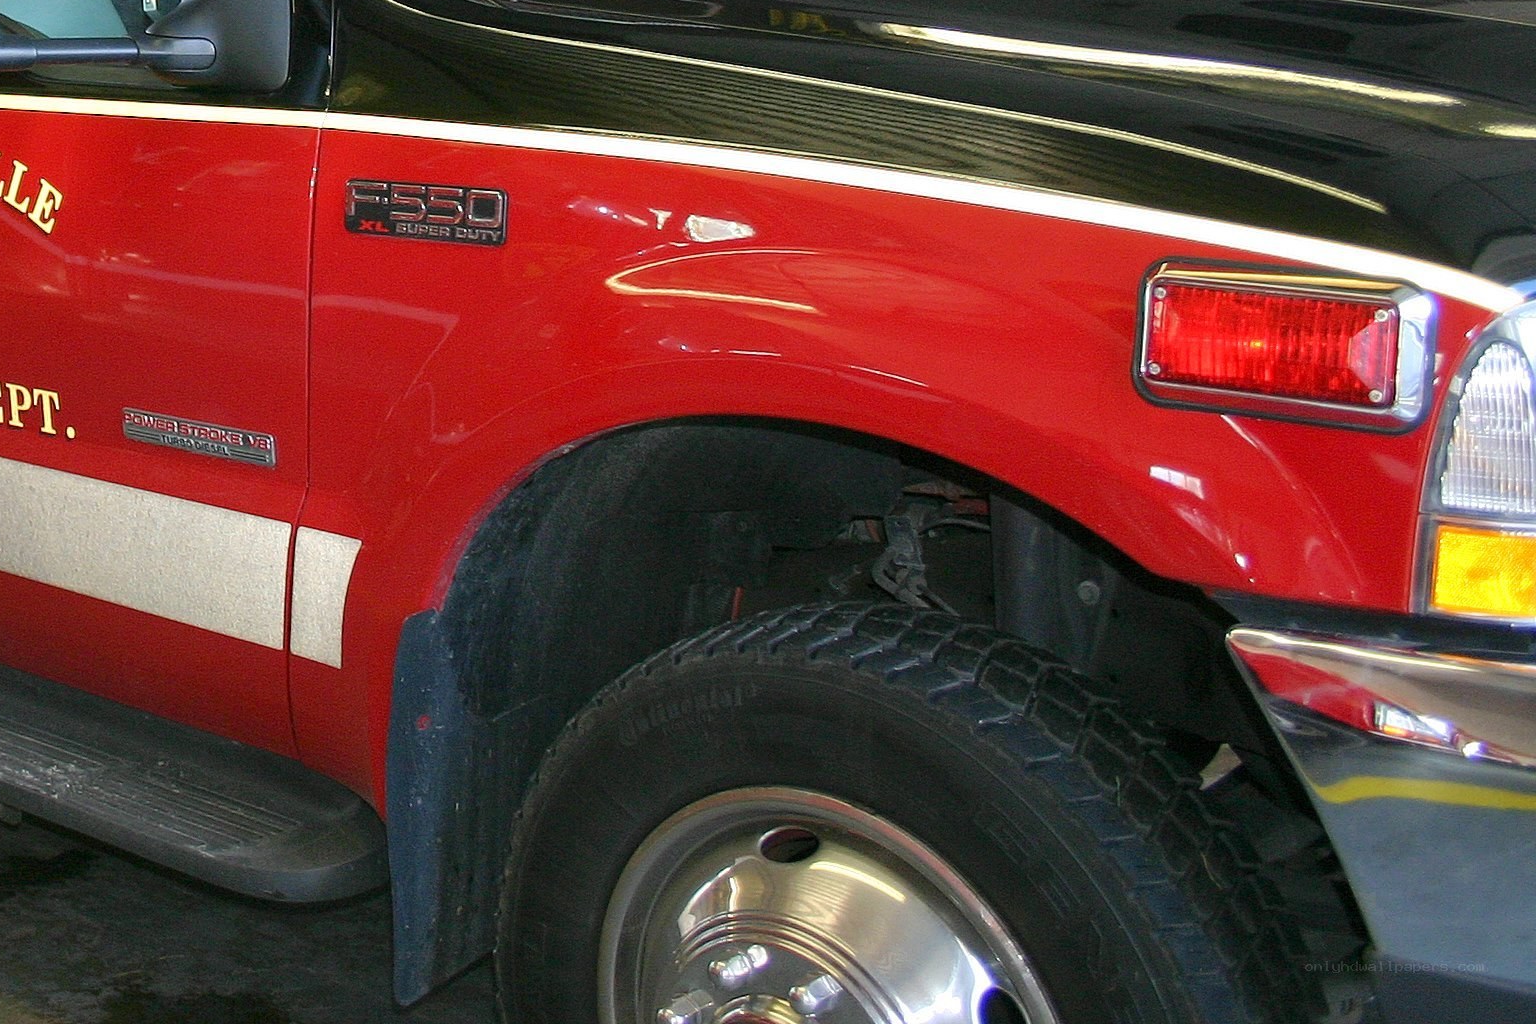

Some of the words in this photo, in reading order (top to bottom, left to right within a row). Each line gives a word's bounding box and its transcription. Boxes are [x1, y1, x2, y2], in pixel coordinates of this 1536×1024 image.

[358, 220, 390, 233] XL
[395, 222, 451, 238] SUPER
[454, 227, 503, 242] DUTY
[124, 412, 177, 433] POWER
[178, 423, 244, 446] STROKE
[247, 434, 272, 450] V8
[194, 440, 231, 456] DIESEL
